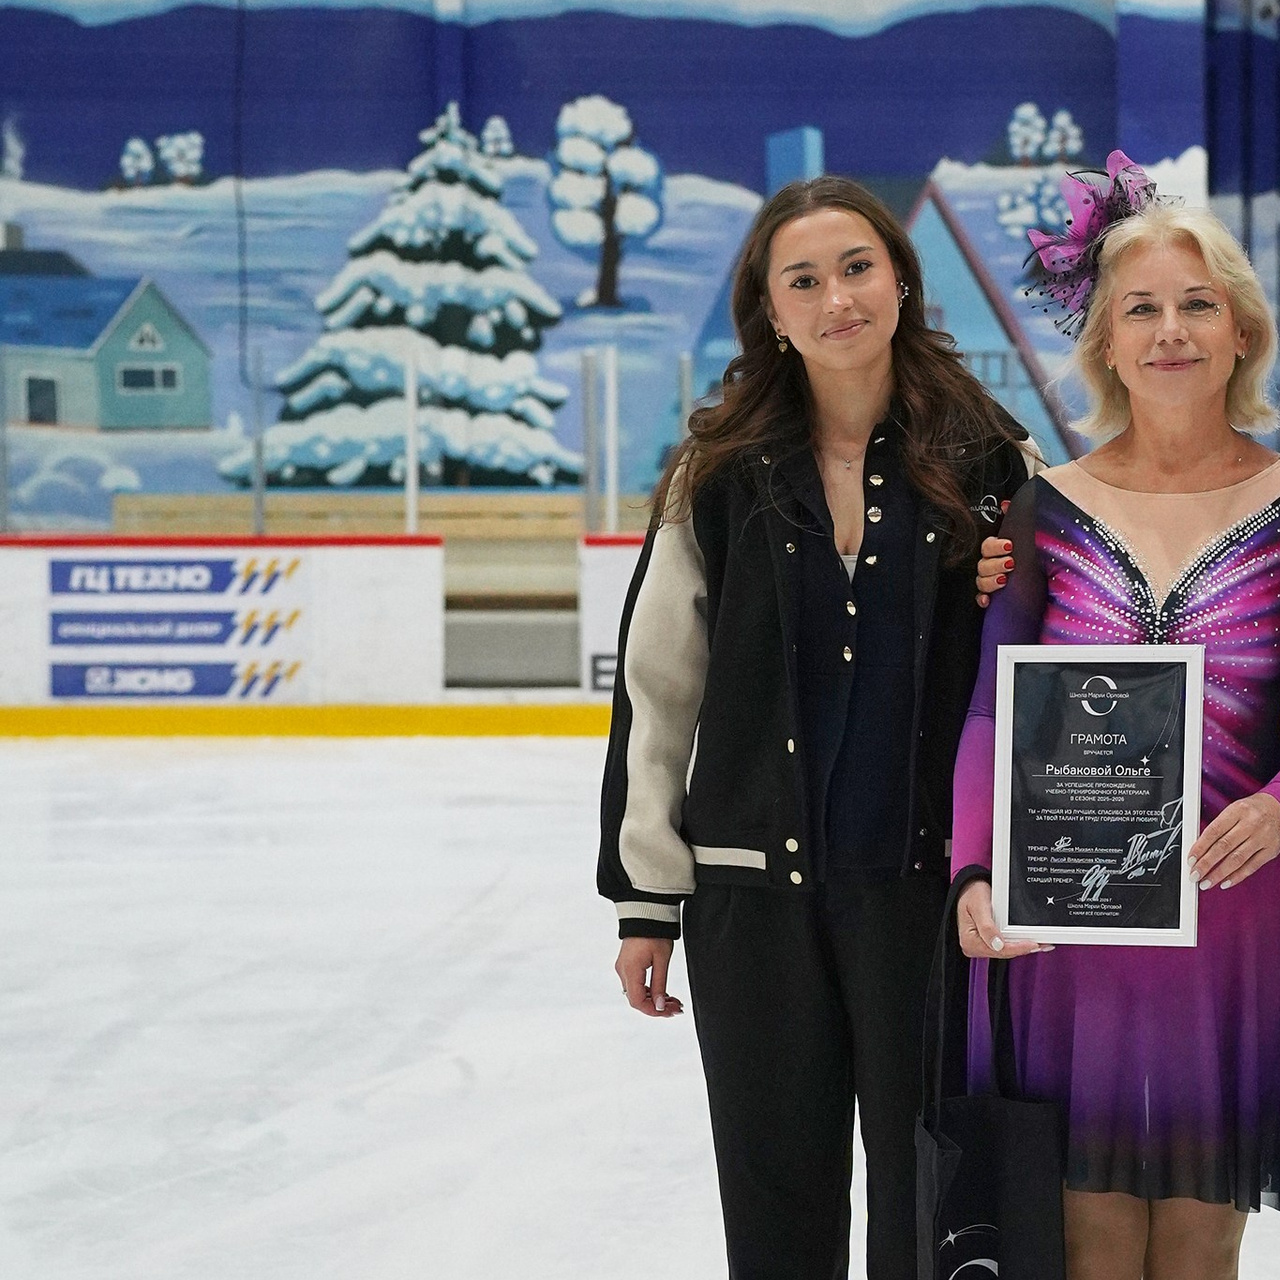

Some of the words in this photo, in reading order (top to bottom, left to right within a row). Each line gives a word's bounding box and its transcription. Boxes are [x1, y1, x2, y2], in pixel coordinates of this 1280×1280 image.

[1070, 733, 1128, 745] ГРАМОТА
[1045, 763, 1112, 776] Рыбаковой
[1114, 764, 1151, 776] Ольге
